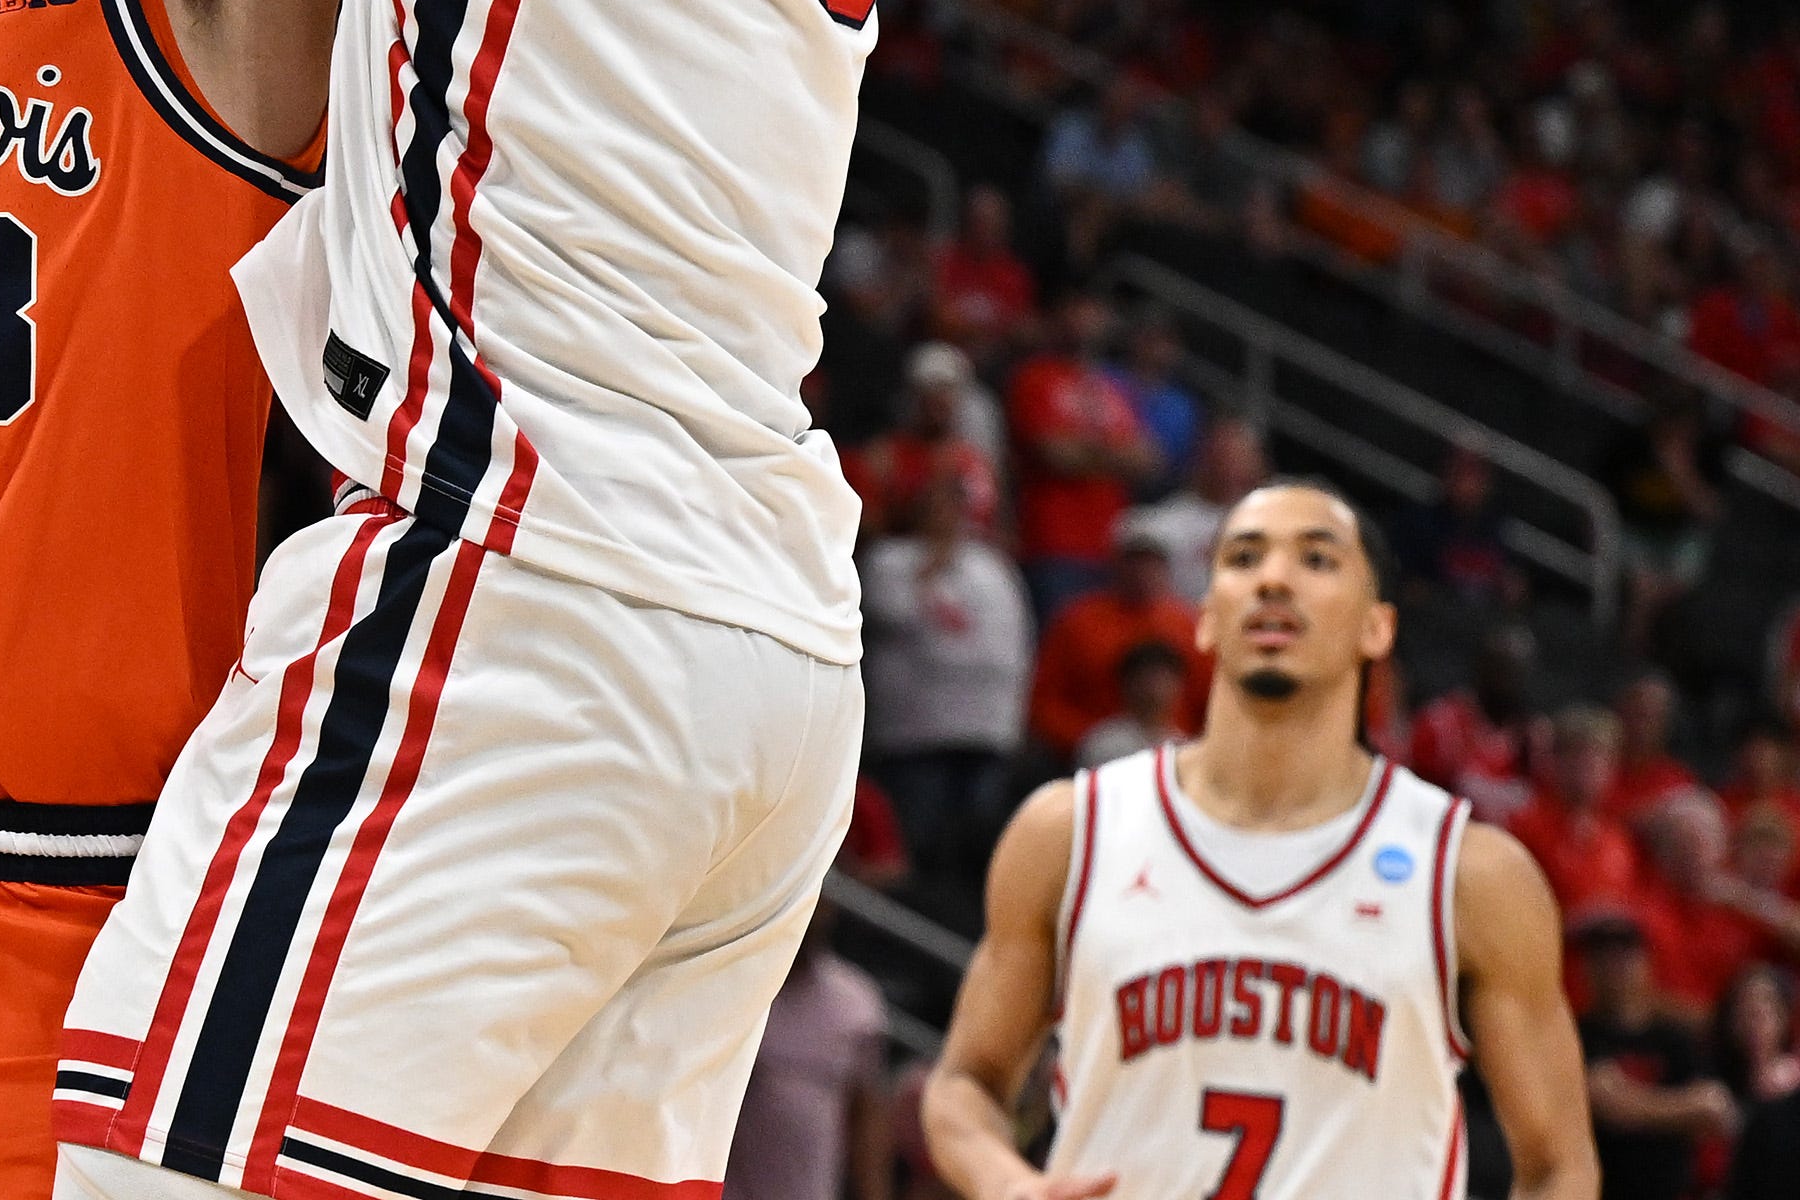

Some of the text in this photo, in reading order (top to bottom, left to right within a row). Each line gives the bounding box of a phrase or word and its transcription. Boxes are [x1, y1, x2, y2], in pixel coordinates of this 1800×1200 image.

[352, 372, 370, 399] XL
[1116, 957, 1387, 1084] HOUSTON
[1200, 1087, 1286, 1200] 7
